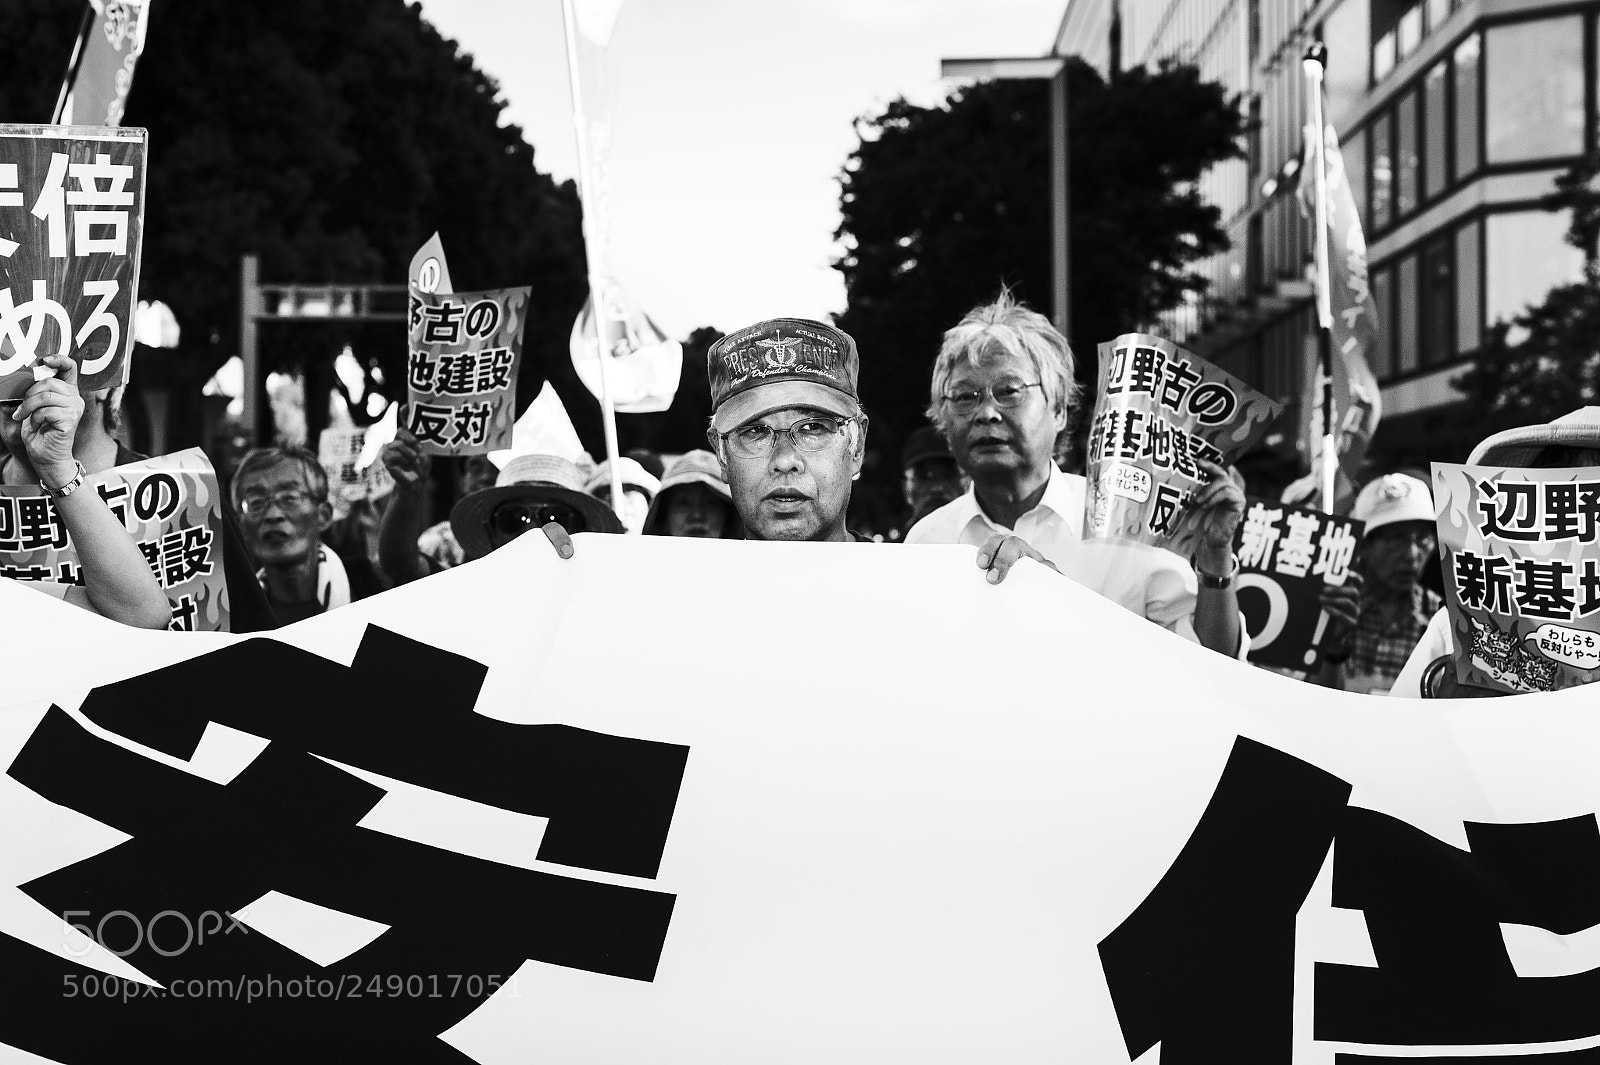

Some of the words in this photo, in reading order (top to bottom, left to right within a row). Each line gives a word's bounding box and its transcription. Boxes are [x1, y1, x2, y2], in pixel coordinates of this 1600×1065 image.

[0, 151, 135, 259] 倍
[409, 403, 491, 447] 反対
[1238, 502, 1357, 588] 新基地
[1548, 629, 1595, 648] わしらも
[1493, 670, 1530, 691] シーサー
